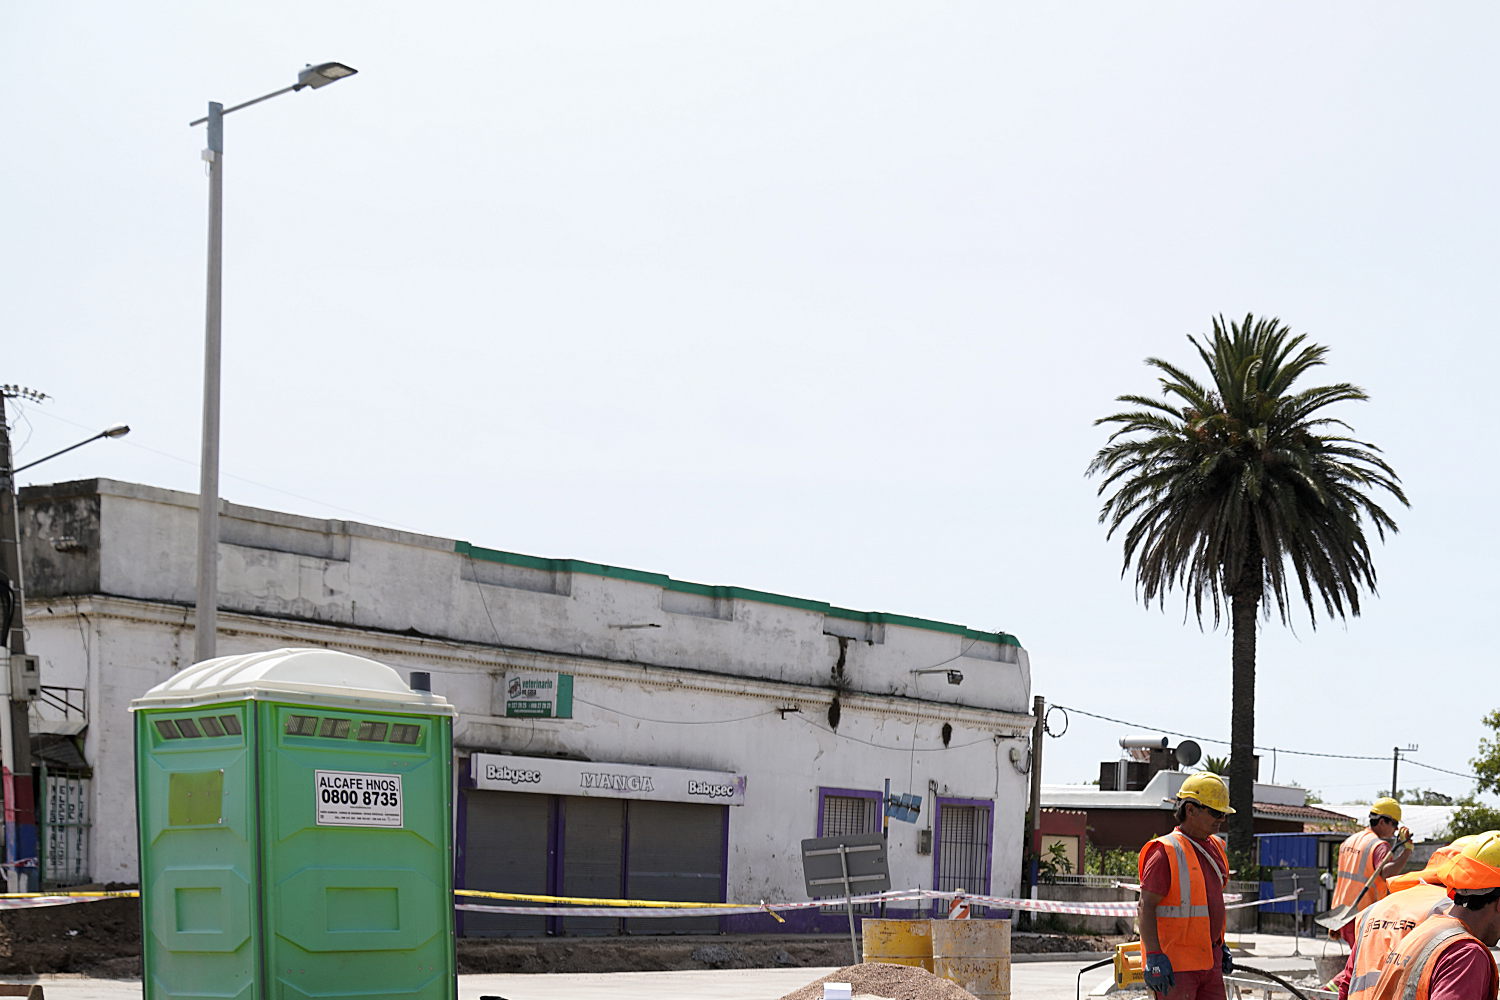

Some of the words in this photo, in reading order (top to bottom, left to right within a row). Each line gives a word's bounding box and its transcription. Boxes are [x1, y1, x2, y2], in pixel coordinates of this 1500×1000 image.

[319, 777, 363, 789] ALCAFE
[366, 779, 399, 791] HNOS.
[485, 765, 541, 784] Babysec
[580, 771, 654, 792] MANGA
[687, 781, 734, 798] Babysec
[322, 789, 358, 804] 0800
[362, 791, 398, 807] 8735
